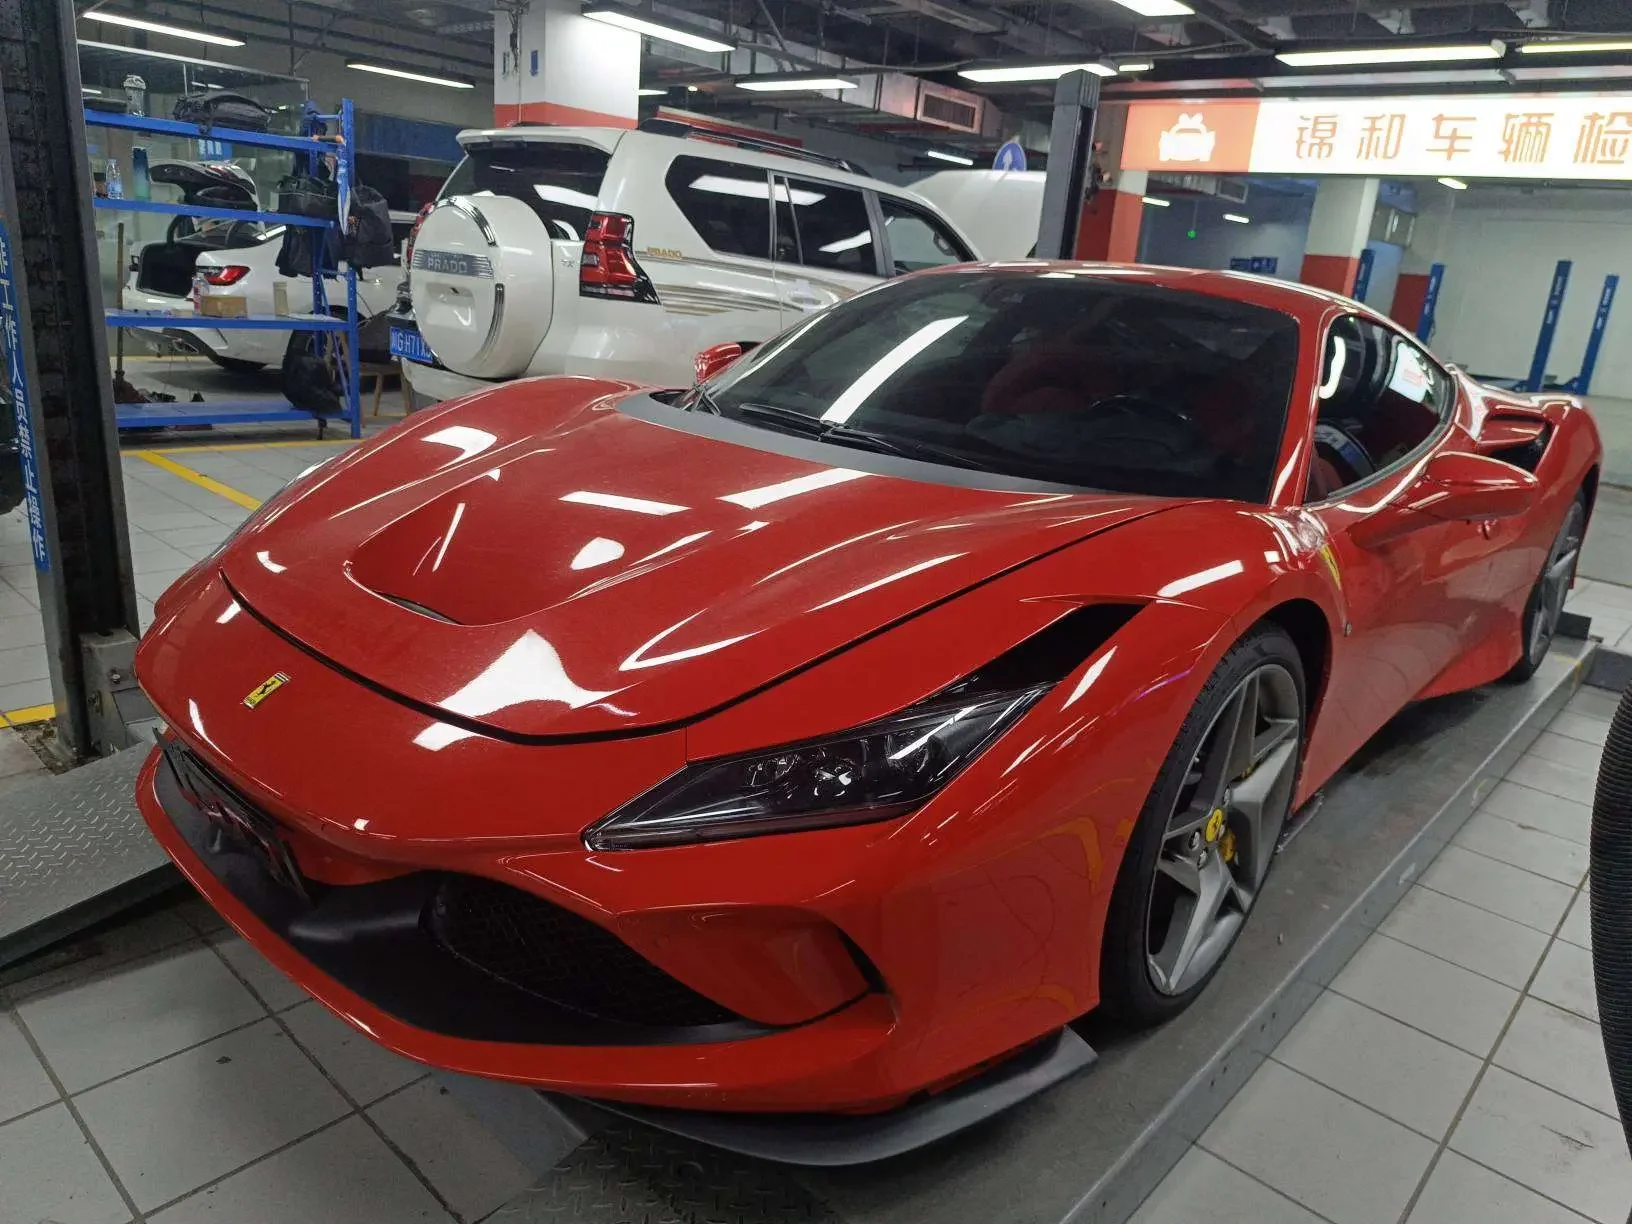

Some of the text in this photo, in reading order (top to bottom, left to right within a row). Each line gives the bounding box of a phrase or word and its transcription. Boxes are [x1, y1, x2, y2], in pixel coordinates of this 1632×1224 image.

[1295, 111, 1632, 164] 锦和车辆检
[647, 247, 681, 259] PRADO
[427, 257, 468, 273] PRADO
